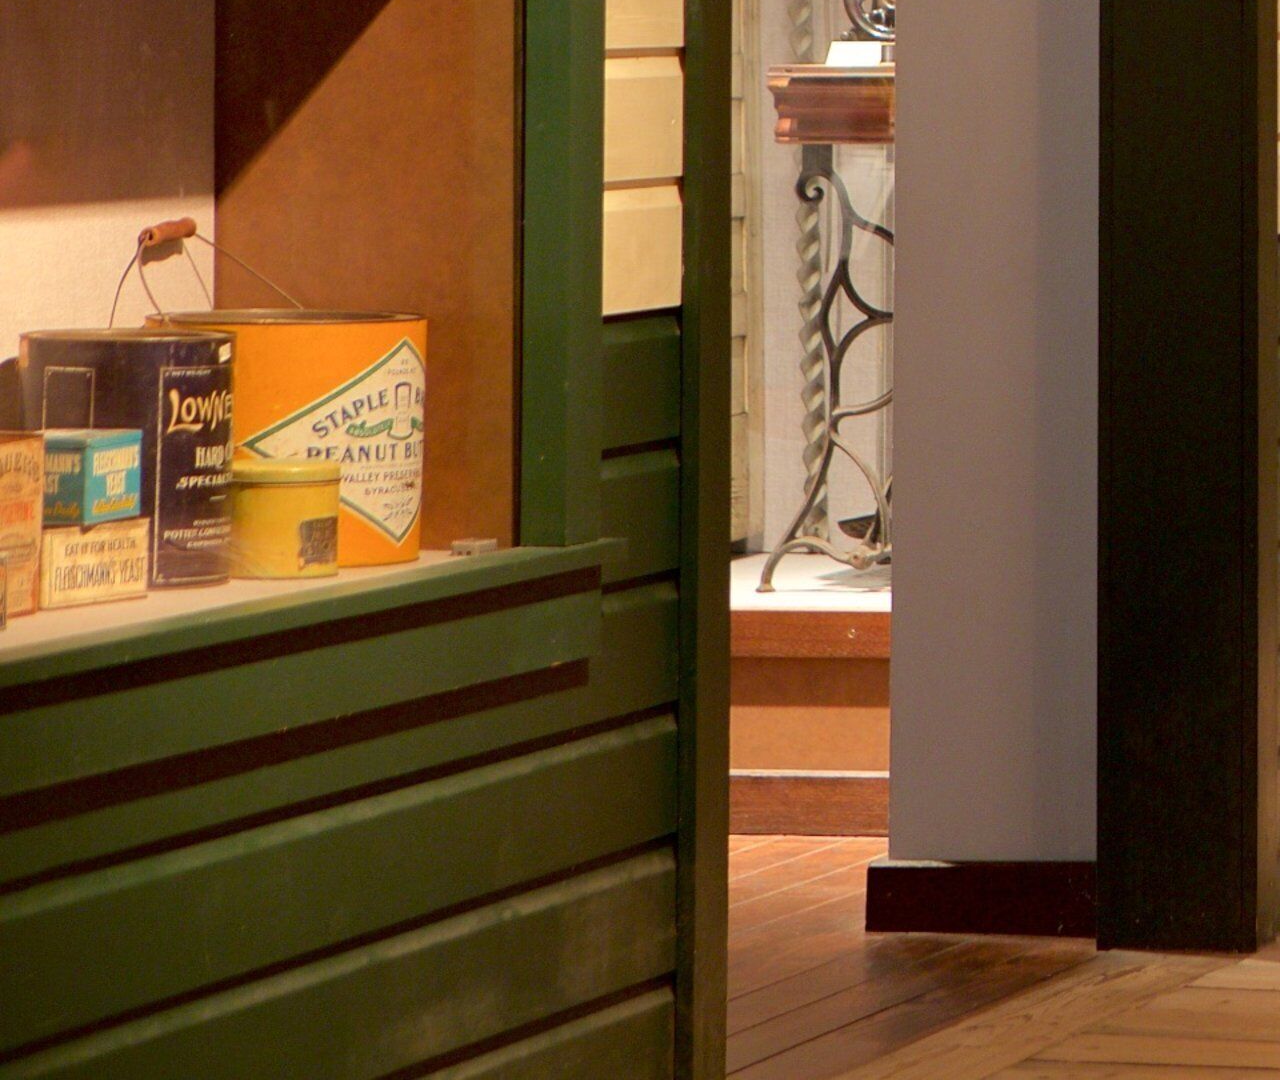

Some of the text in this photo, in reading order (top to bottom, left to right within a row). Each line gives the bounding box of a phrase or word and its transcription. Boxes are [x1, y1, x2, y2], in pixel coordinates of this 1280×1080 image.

[311, 387, 389, 439] STAPLE
[306, 440, 397, 464] PEANUT
[342, 470, 381, 485] VALLEY
[65, 543, 79, 557] EAT
[90, 541, 105, 553] FOR
[107, 536, 137, 551] HEALTH
[120, 556, 146, 585] YEAST
